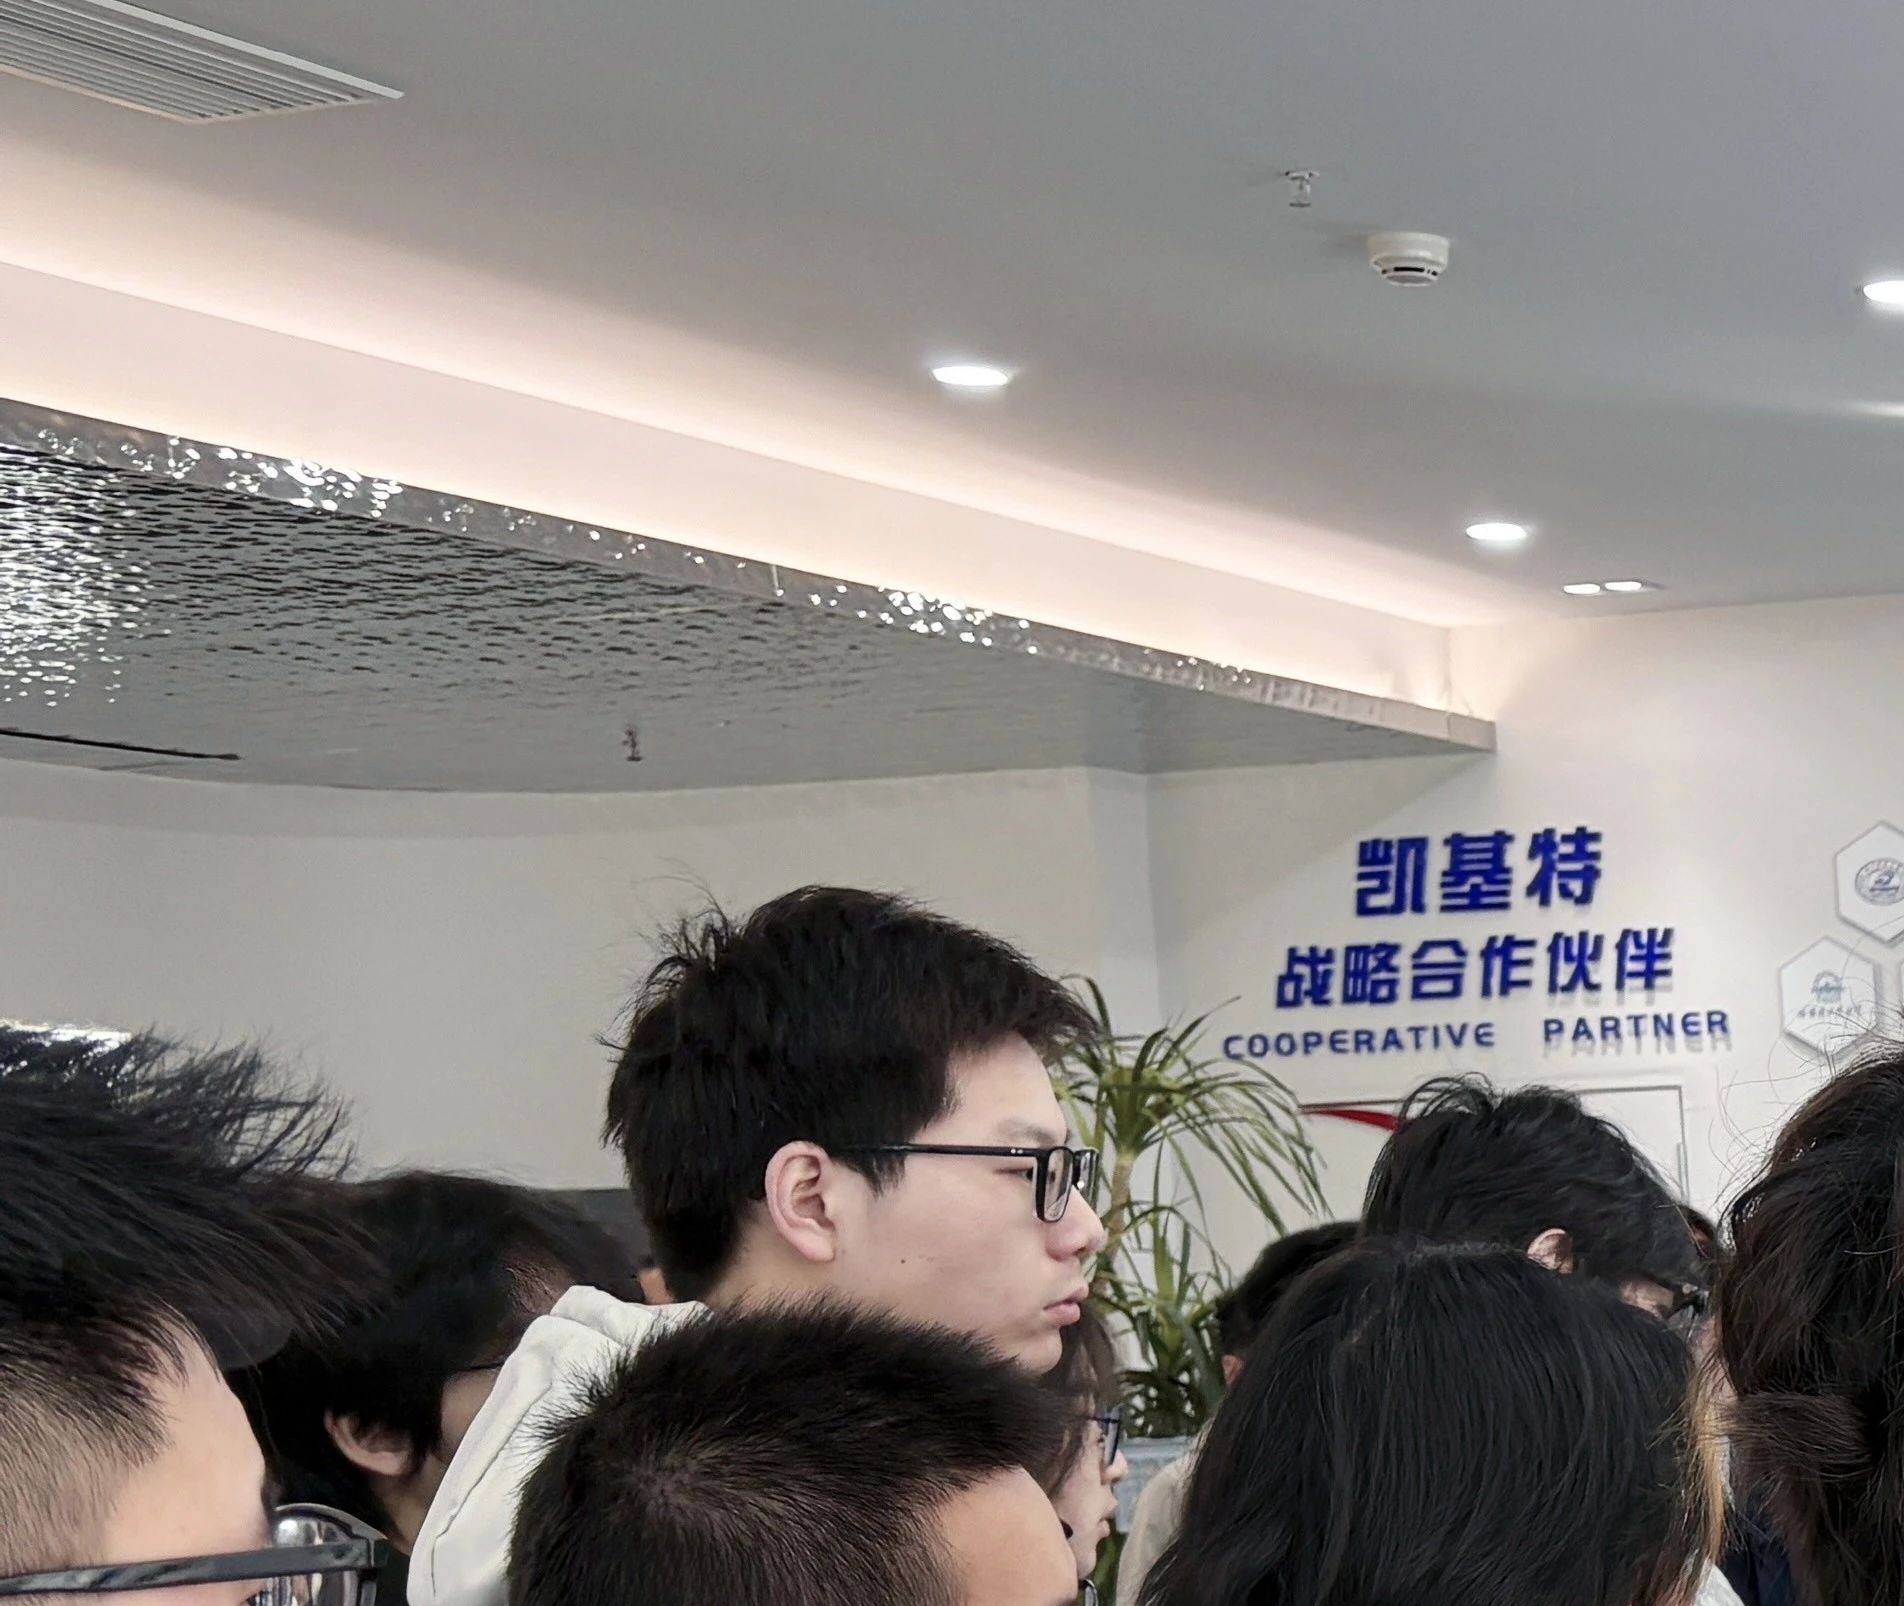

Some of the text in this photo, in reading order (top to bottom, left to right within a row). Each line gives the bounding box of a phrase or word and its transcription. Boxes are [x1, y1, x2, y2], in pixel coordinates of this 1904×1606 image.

[1355, 826, 1603, 917] 凯基特
[1276, 927, 1675, 1009] 战略合作伙伴
[1223, 1010, 1729, 1060] COOPERATIVE PARTNER
